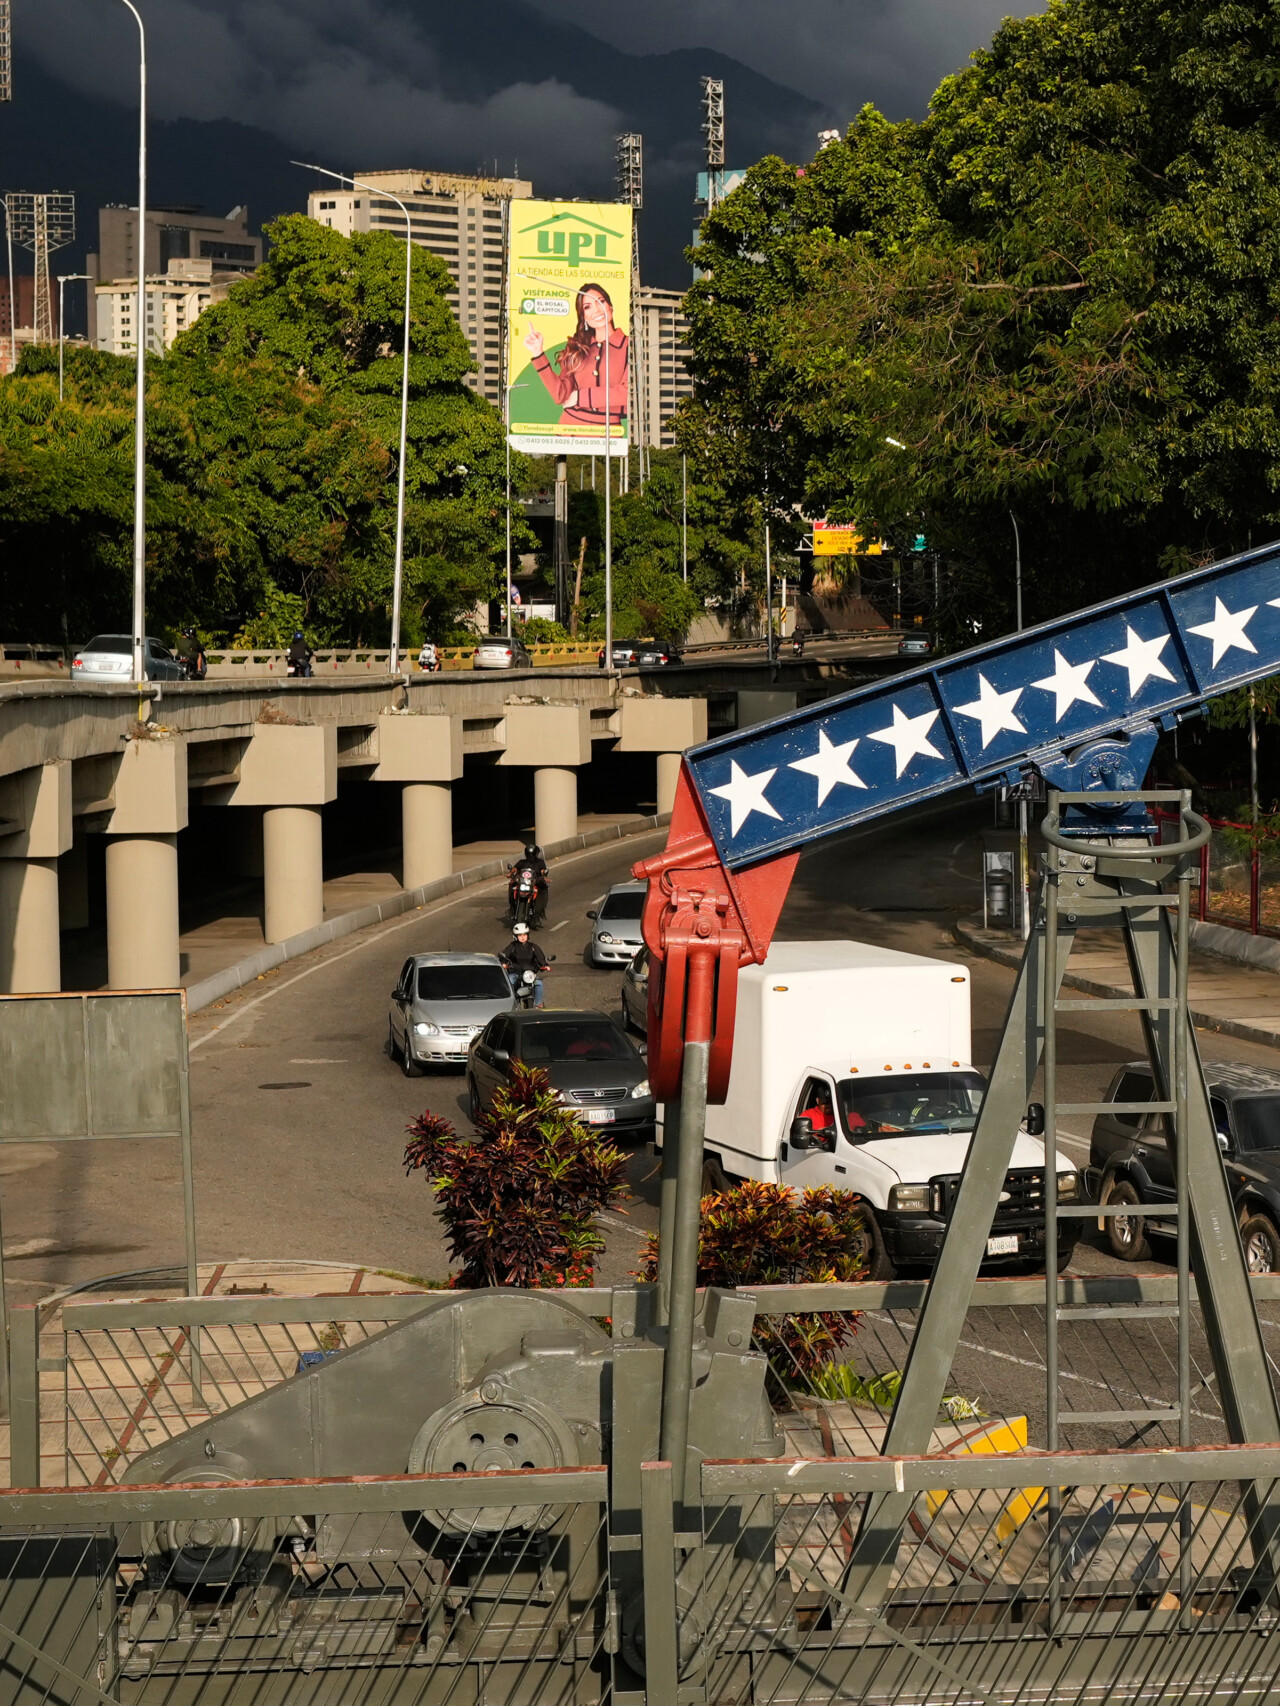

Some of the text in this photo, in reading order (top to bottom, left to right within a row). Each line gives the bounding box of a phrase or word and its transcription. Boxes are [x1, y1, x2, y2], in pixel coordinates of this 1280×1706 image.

[528, 267, 553, 276] TIENDA
[554, 268, 564, 276] DE
[565, 269, 578, 277] LAS
[580, 270, 625, 279] SOLUCIONES
[522, 288, 570, 298] VISÍTANOS
